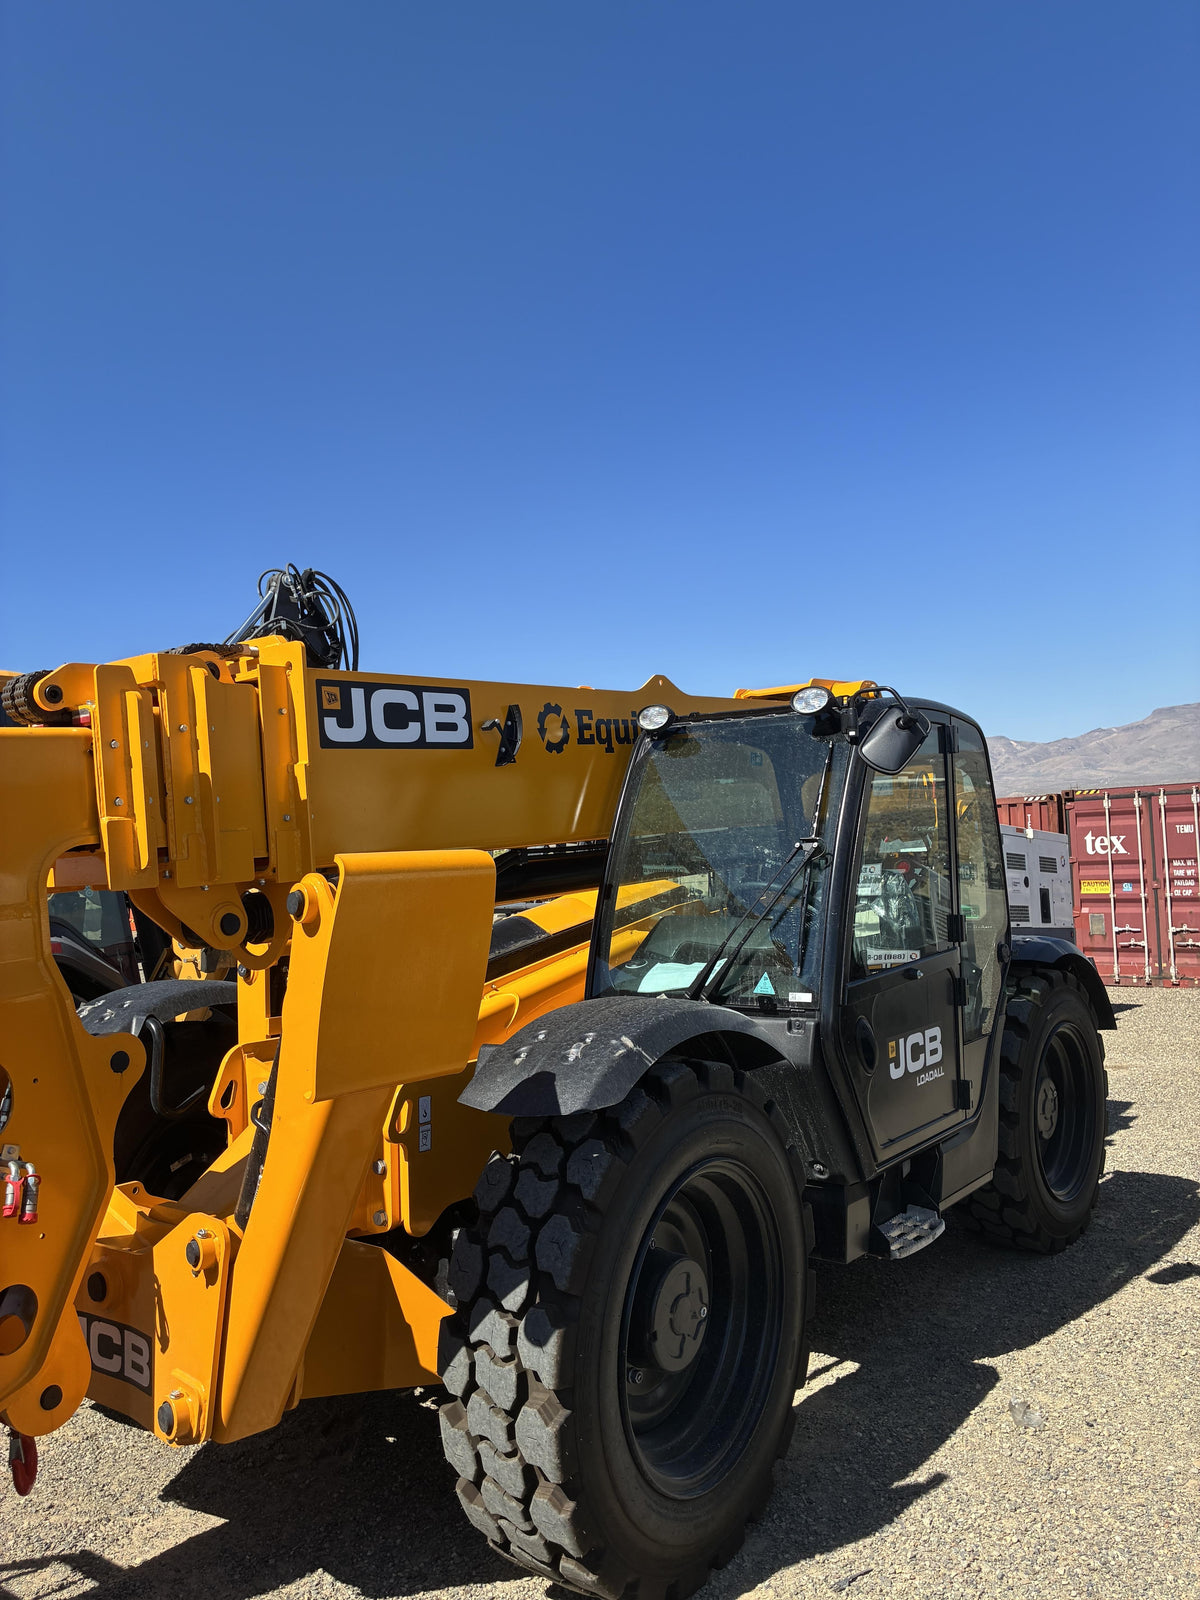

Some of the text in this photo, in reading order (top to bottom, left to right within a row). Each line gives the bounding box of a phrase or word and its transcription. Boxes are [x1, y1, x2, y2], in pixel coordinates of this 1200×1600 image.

[323, 687, 470, 743] JCB
[1175, 824, 1194, 834] TEMU
[1185, 859, 1197, 867] WT.
[1173, 879, 1195, 887] PAYLOAD
[1182, 889, 1194, 897] CAP.
[889, 1026, 943, 1080] JCB
[916, 1066, 945, 1087] LOADALL
